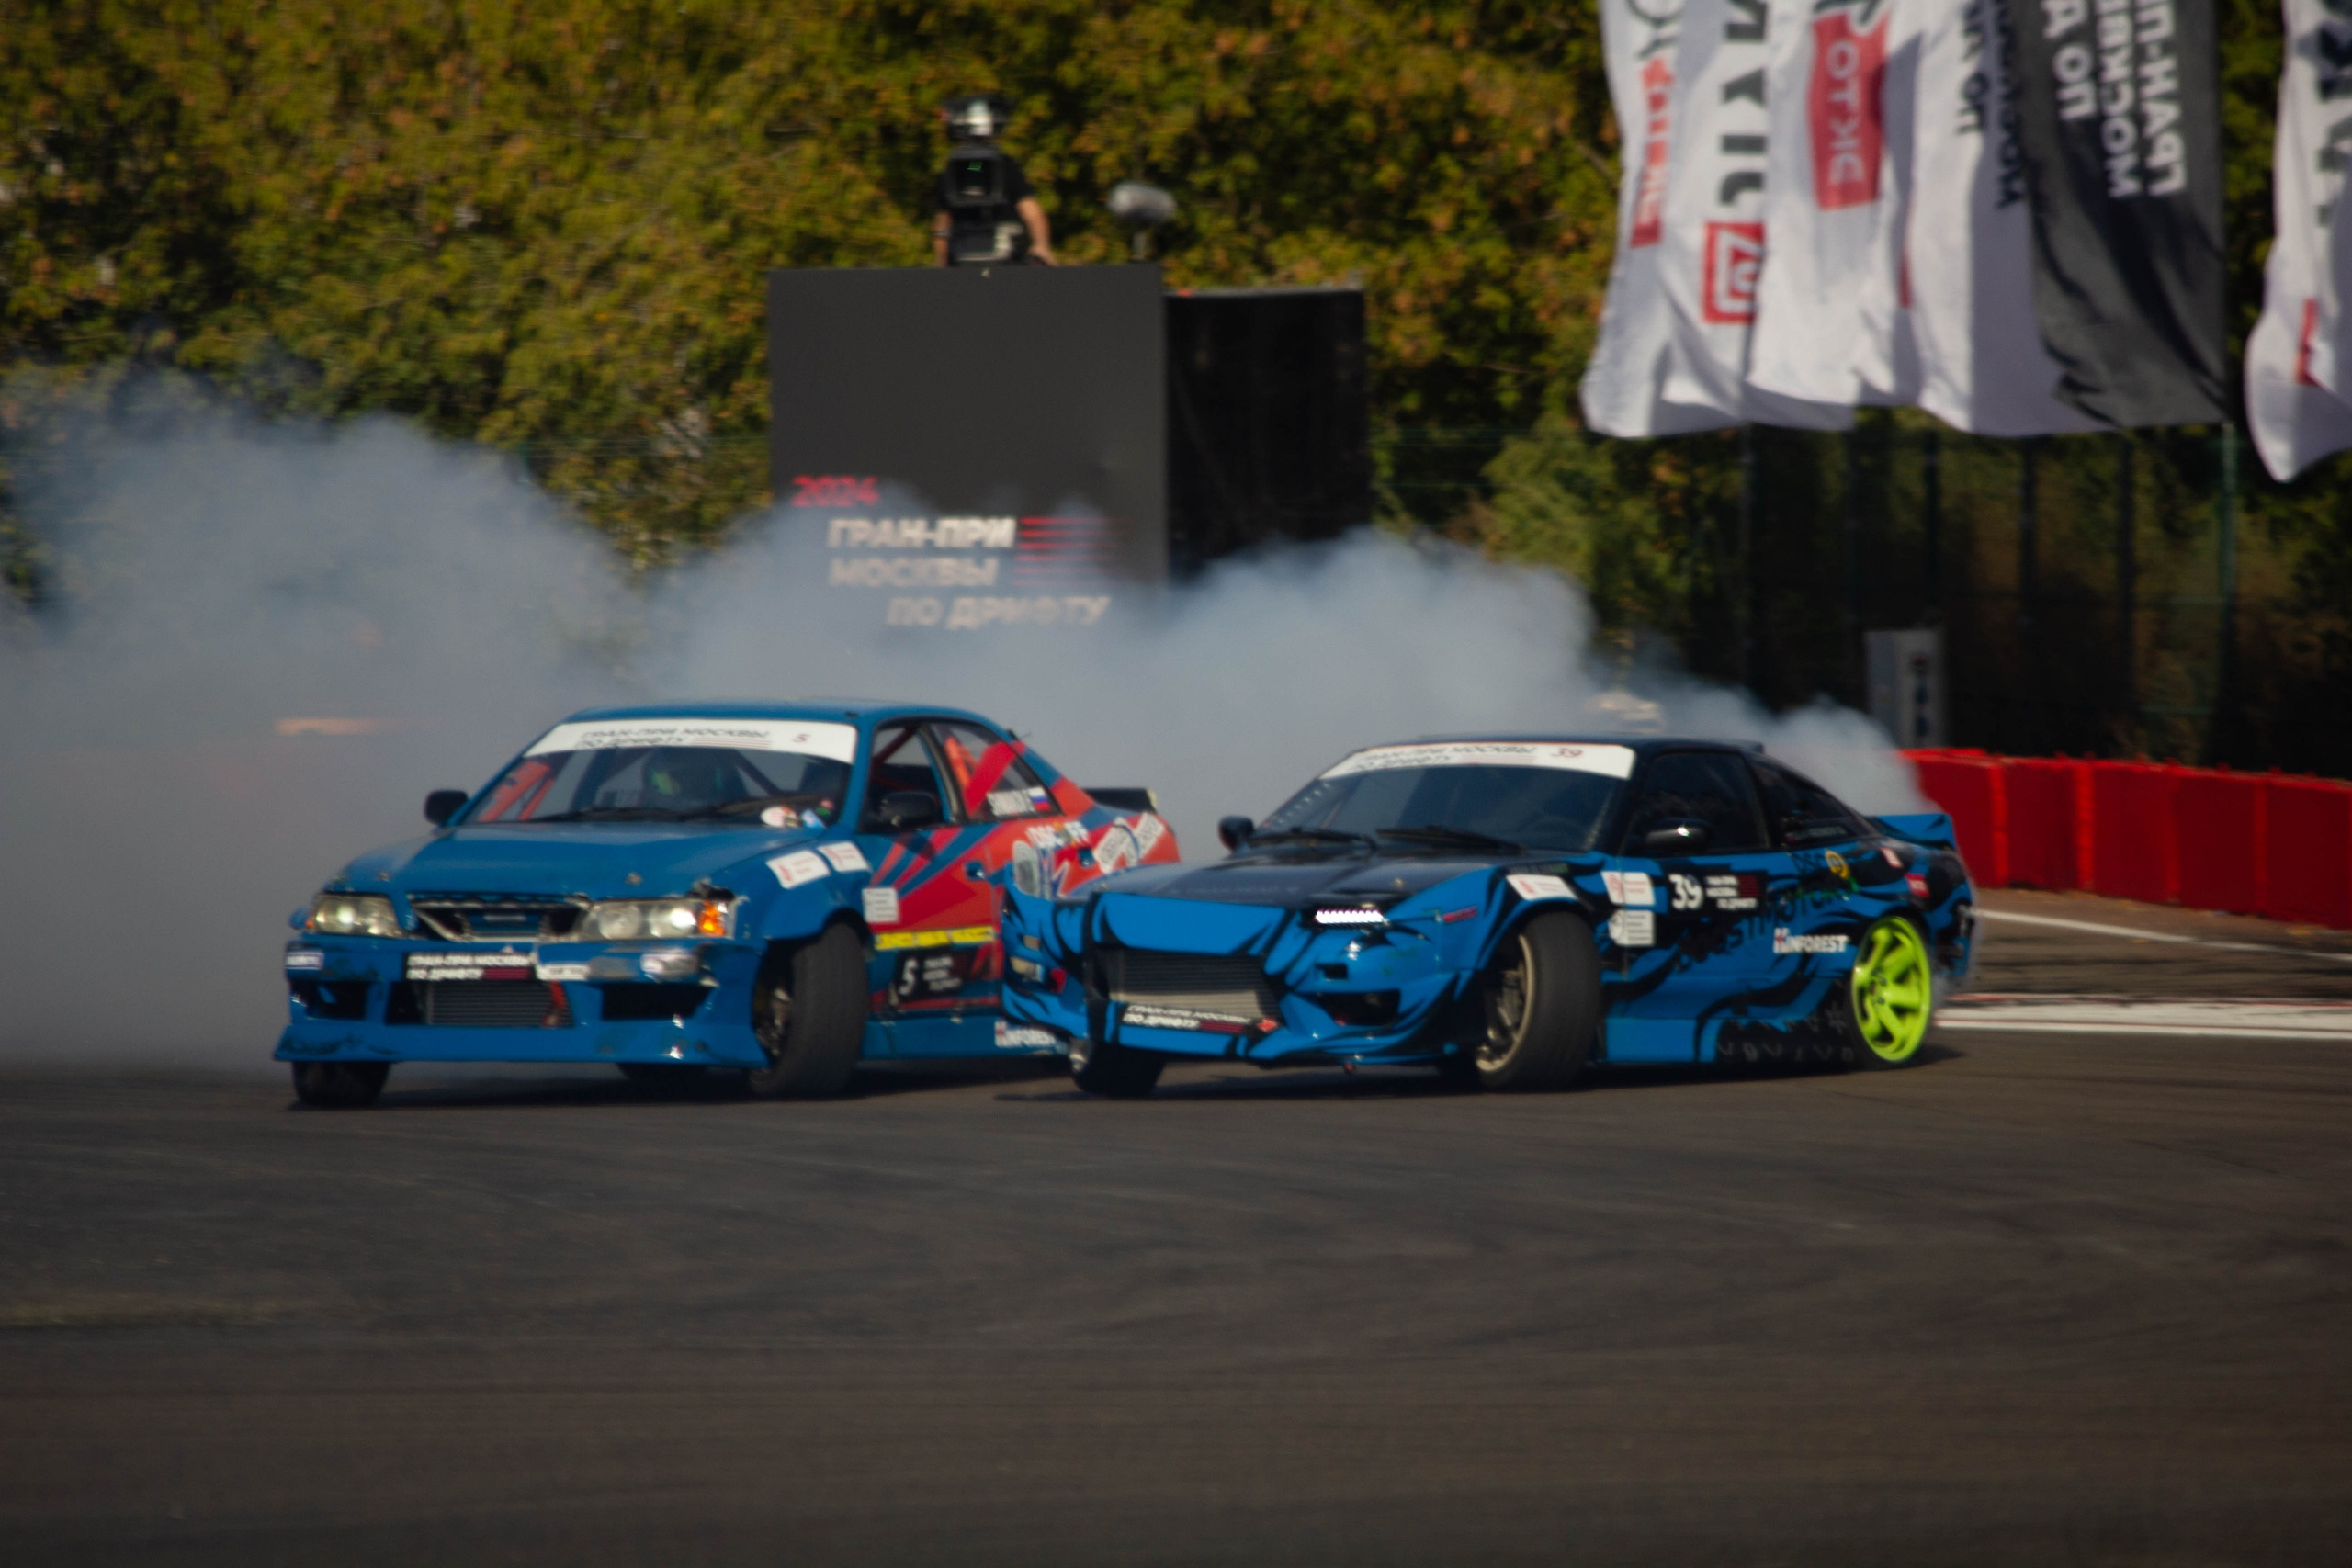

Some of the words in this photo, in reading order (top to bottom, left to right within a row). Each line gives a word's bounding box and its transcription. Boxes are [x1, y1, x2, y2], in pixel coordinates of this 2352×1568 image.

[790, 474, 881, 507] 2024
[828, 516, 1017, 548] ГРАН-ПРИ
[830, 557, 1000, 587] МОСКВЫ
[886, 596, 944, 626] ПО
[945, 595, 1112, 630] ДРИФТУ
[1668, 873, 1704, 910] 39
[899, 957, 918, 995] 5
